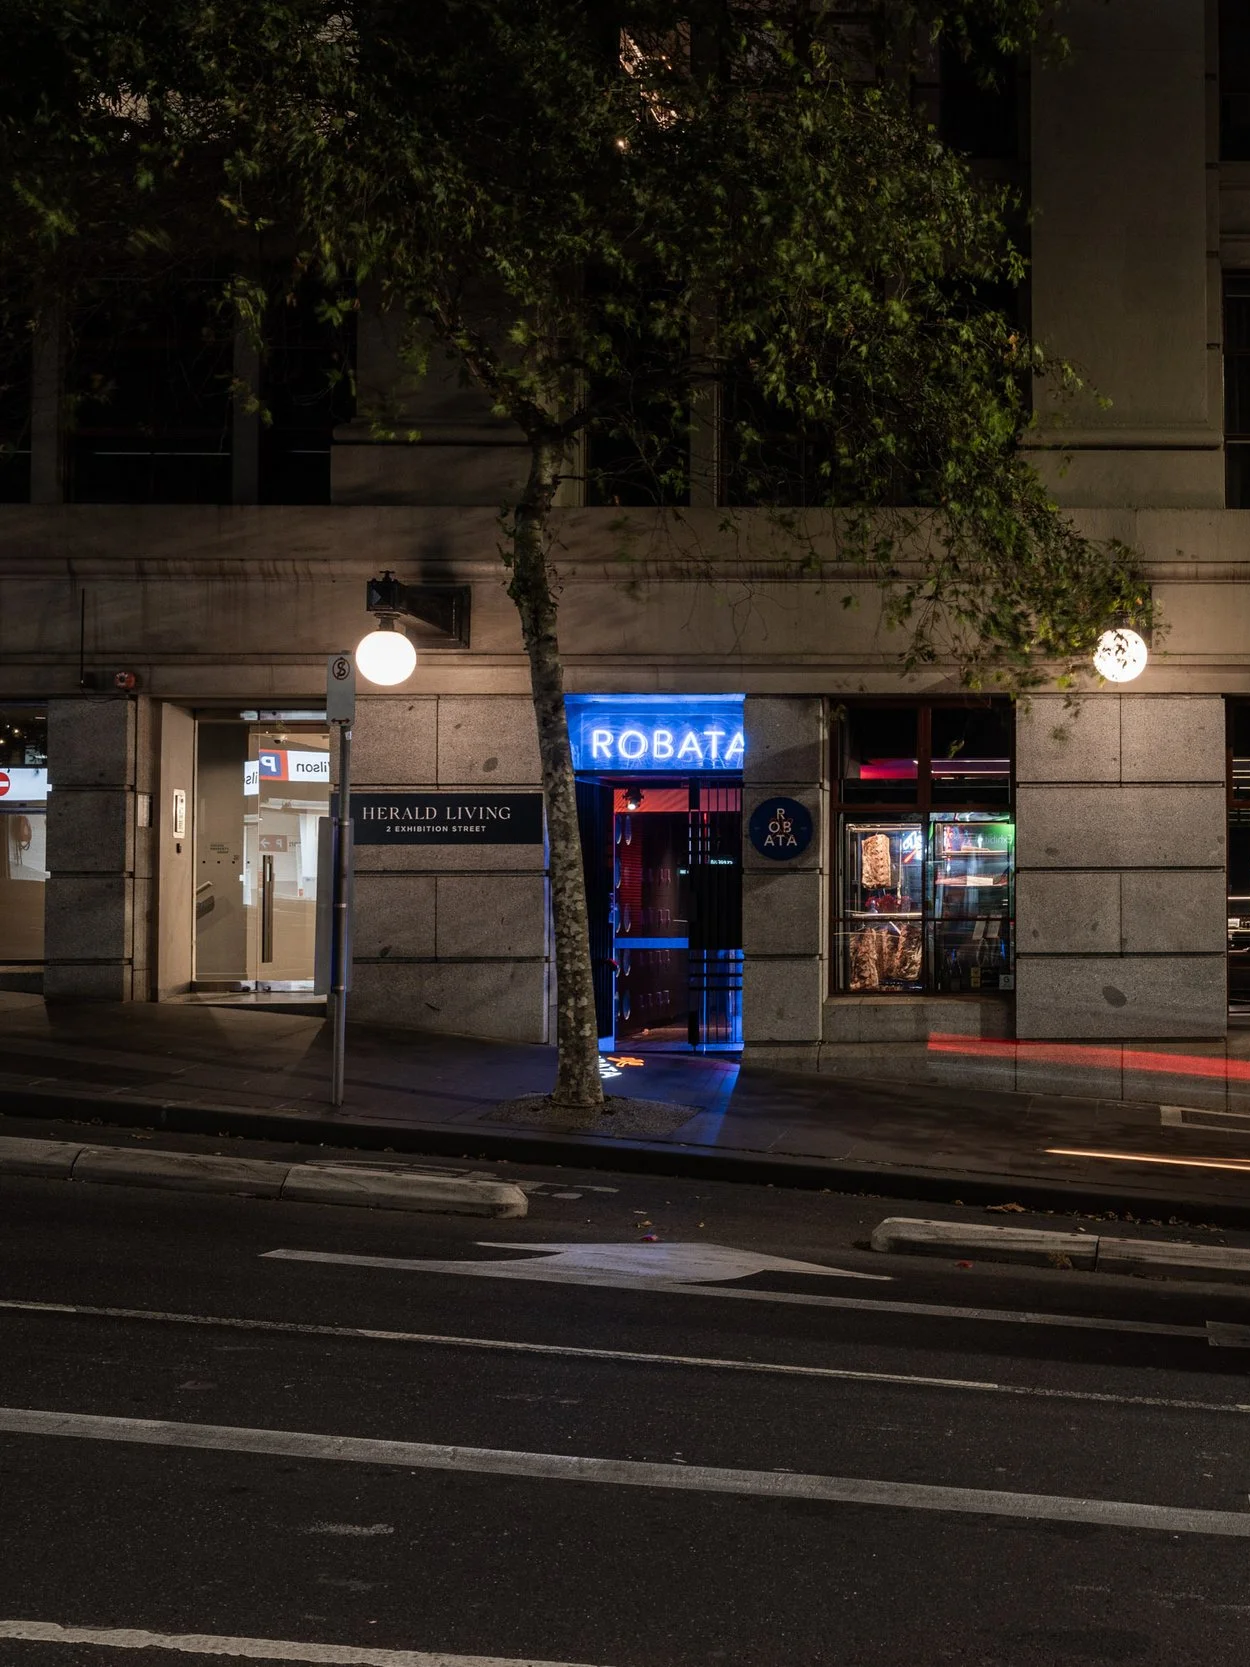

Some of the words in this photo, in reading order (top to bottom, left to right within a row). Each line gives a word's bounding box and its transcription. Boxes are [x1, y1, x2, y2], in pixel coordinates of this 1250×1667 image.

[591, 729, 745, 760] ROBATA
[363, 806, 437, 820] HERALD
[446, 806, 511, 820] LIVING
[763, 835, 798, 846] ATA
